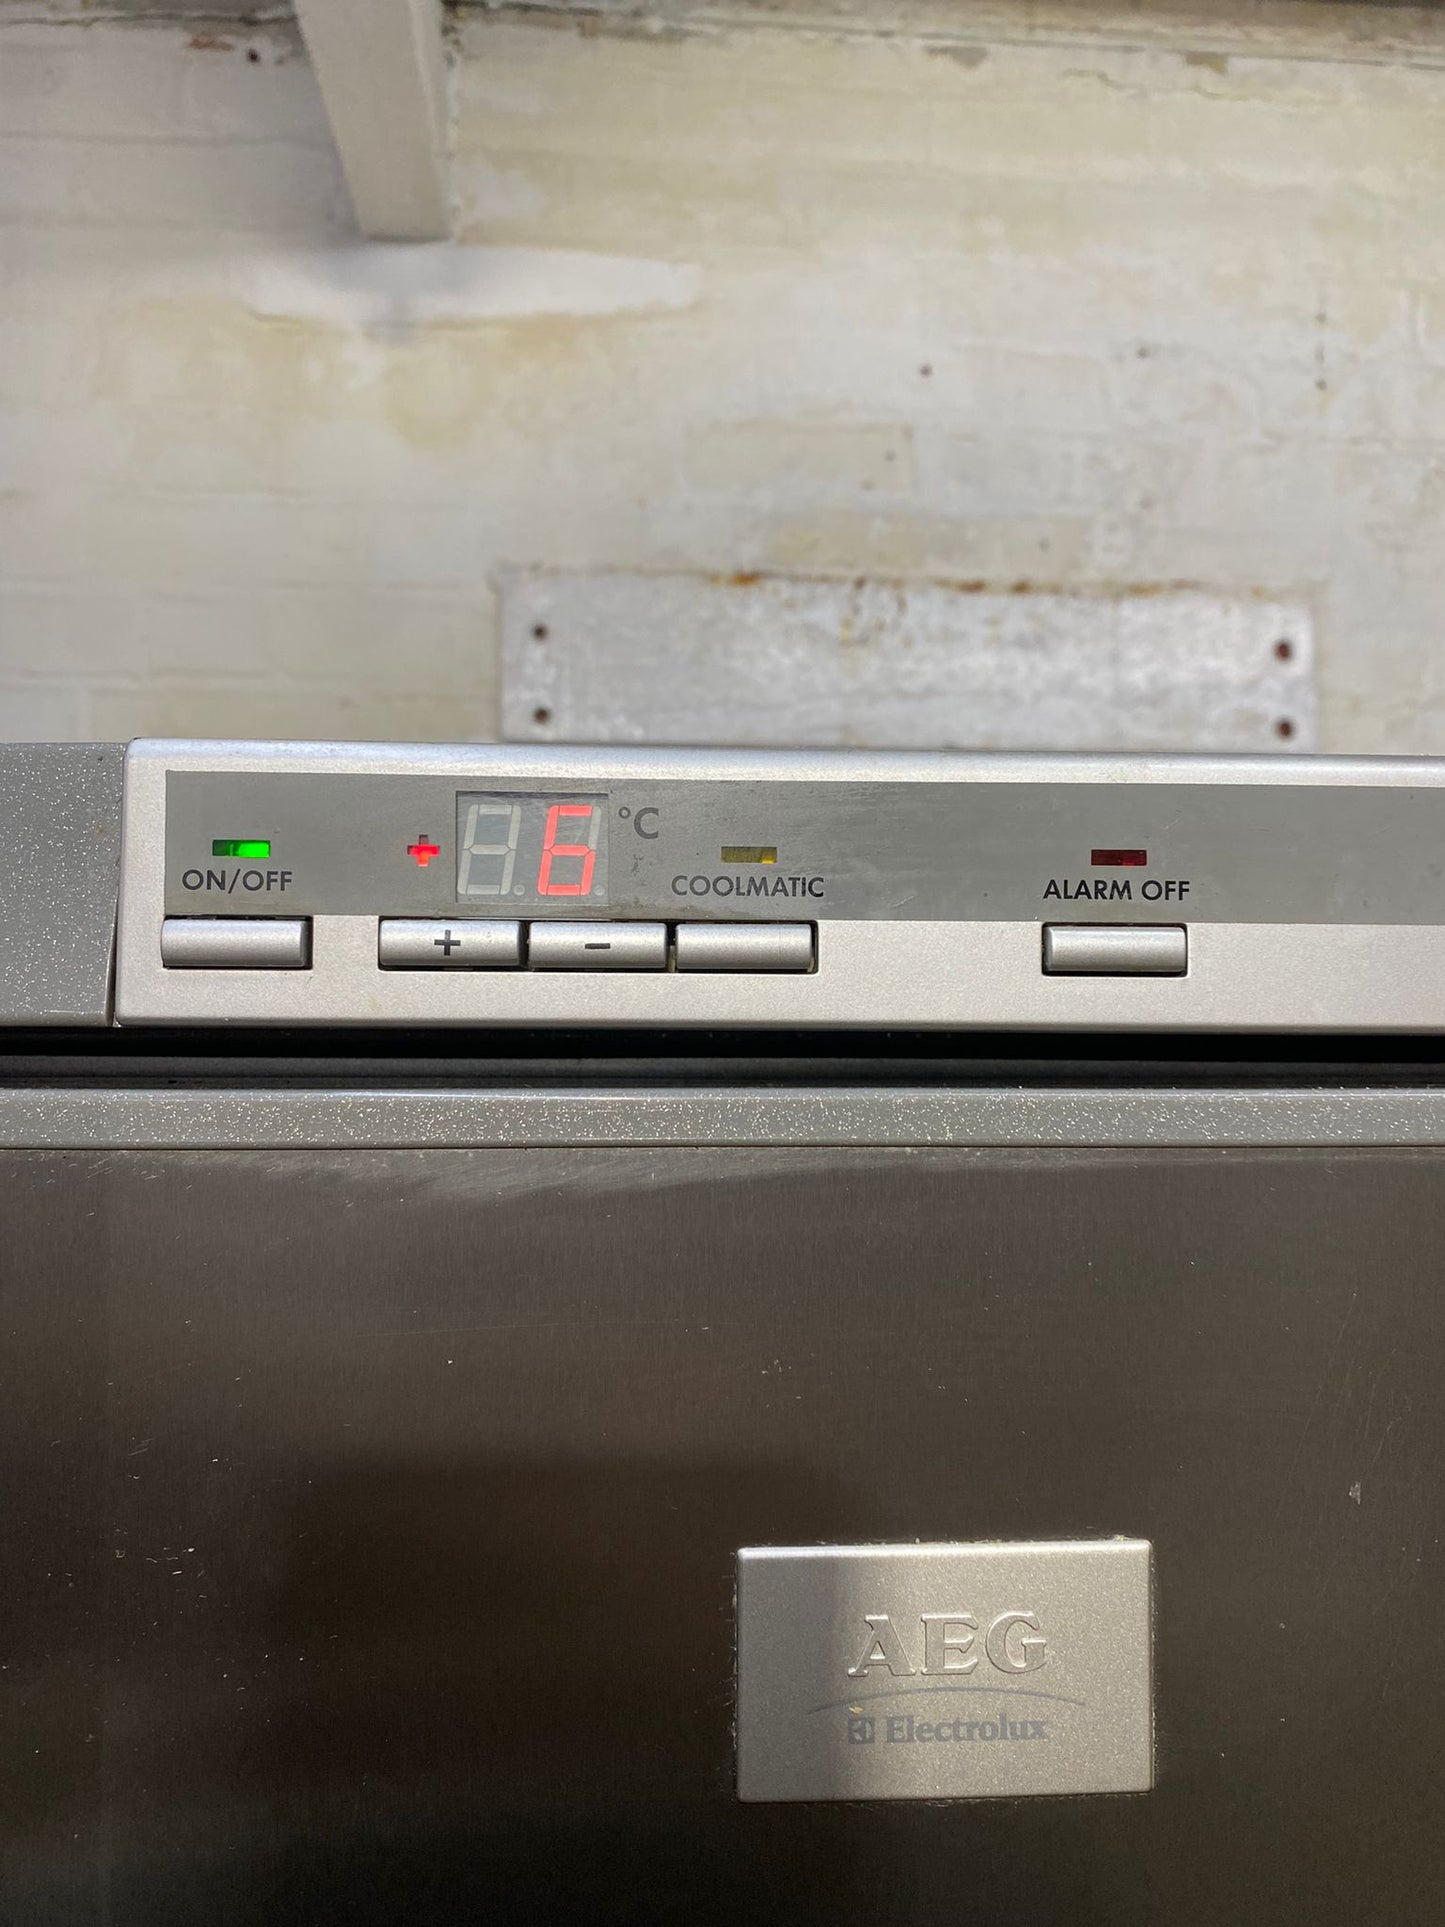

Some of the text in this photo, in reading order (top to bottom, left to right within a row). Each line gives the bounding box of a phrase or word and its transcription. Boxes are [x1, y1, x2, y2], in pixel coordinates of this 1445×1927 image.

[618, 806, 660, 840] °C
[537, 804, 597, 897] 6
[181, 869, 293, 893] ON/OFF
[671, 875, 825, 899] COOLMATIC
[1043, 879, 1191, 901] ALARM OFF
[847, 1610, 1048, 1677] AEG
[886, 1712, 1050, 1743] Electrolux
